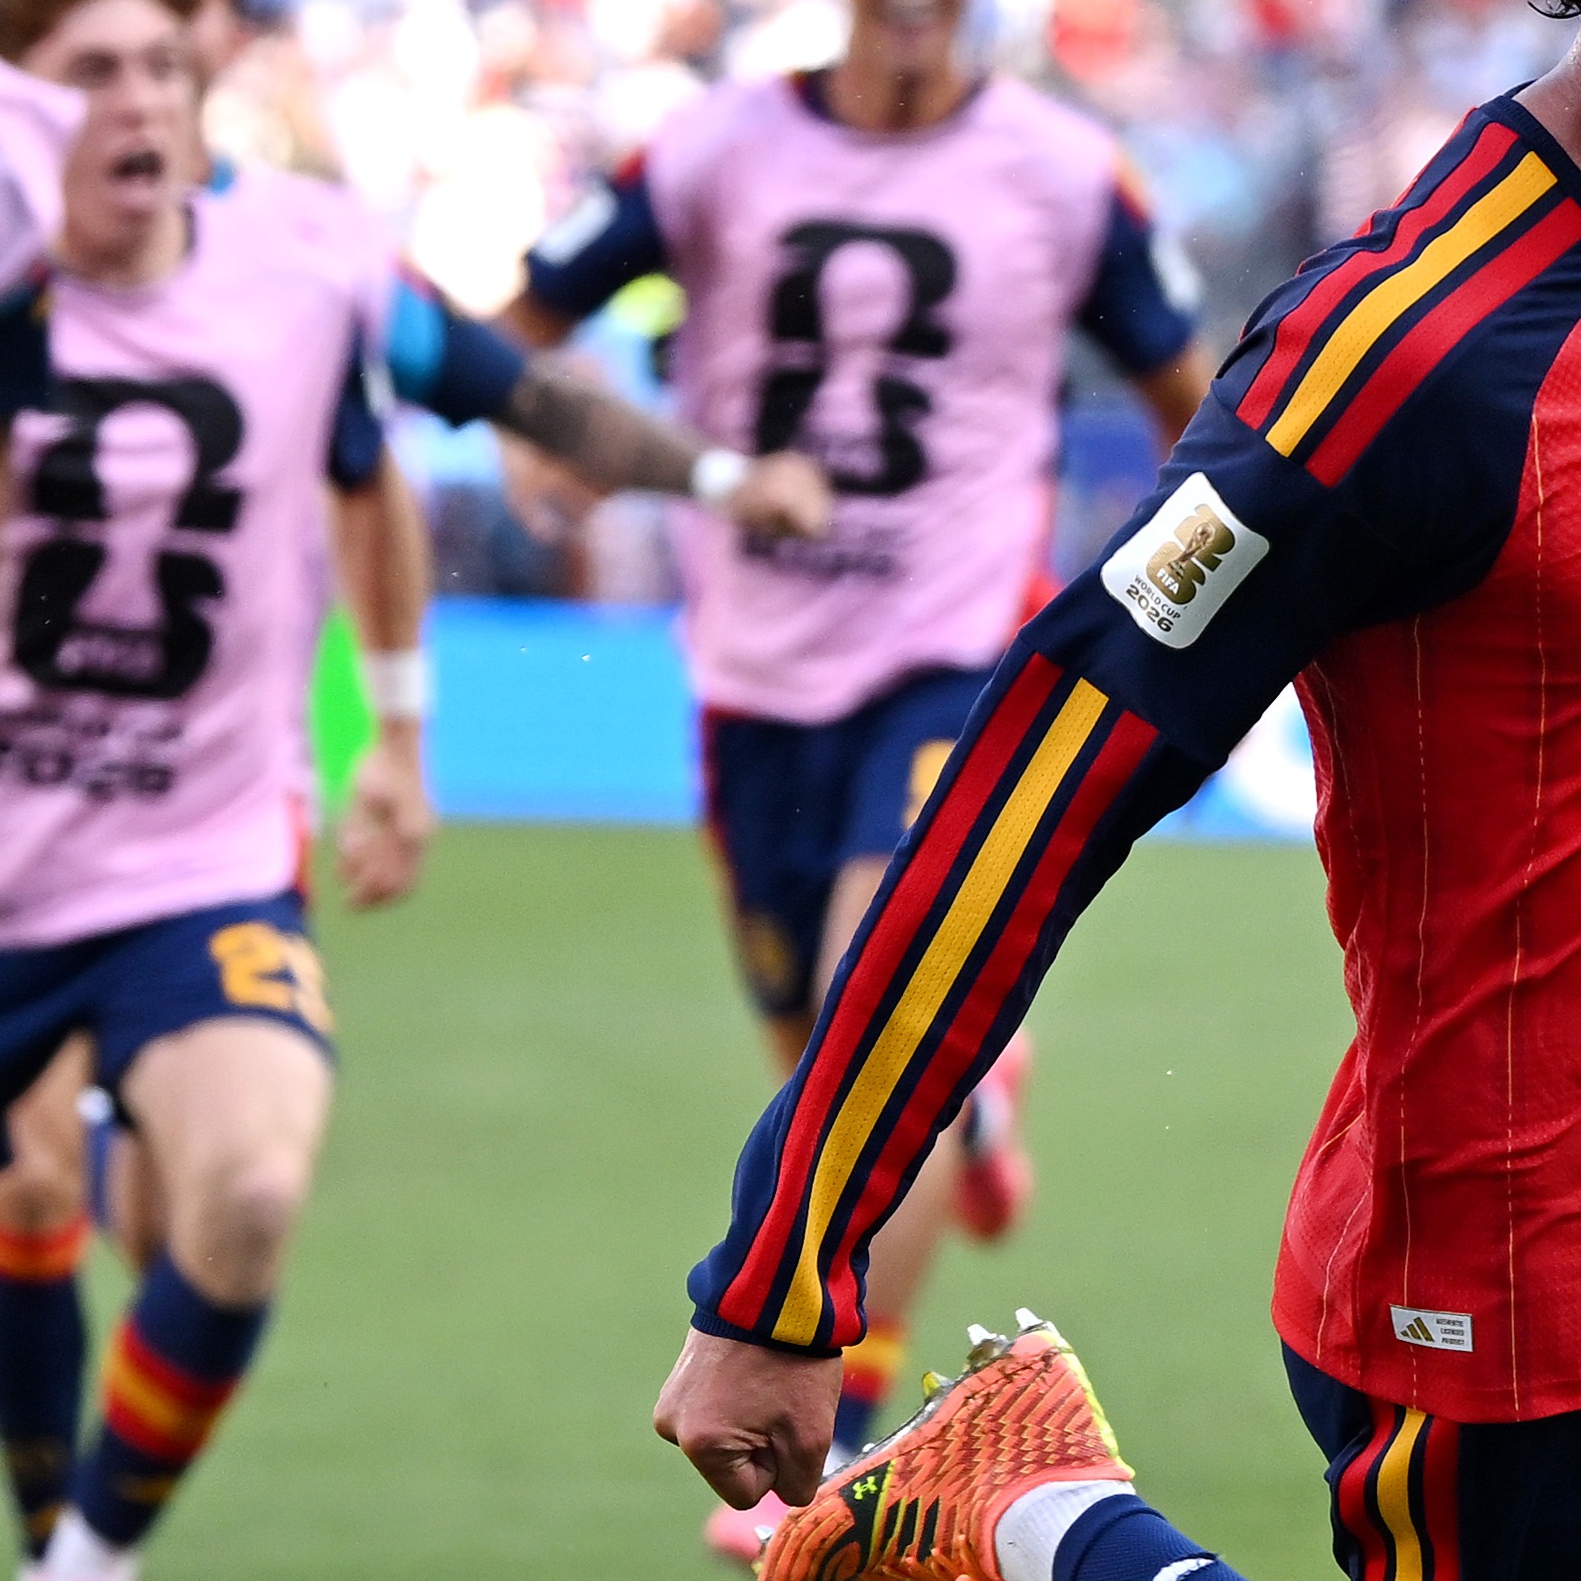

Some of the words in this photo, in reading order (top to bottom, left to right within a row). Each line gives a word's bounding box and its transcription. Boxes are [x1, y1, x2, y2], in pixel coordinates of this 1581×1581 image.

[1134, 575, 1161, 606] WORLD
[1161, 603, 1182, 619] CUP
[1156, 568, 1180, 595] FIFA
[1125, 584, 1175, 633] 2026
